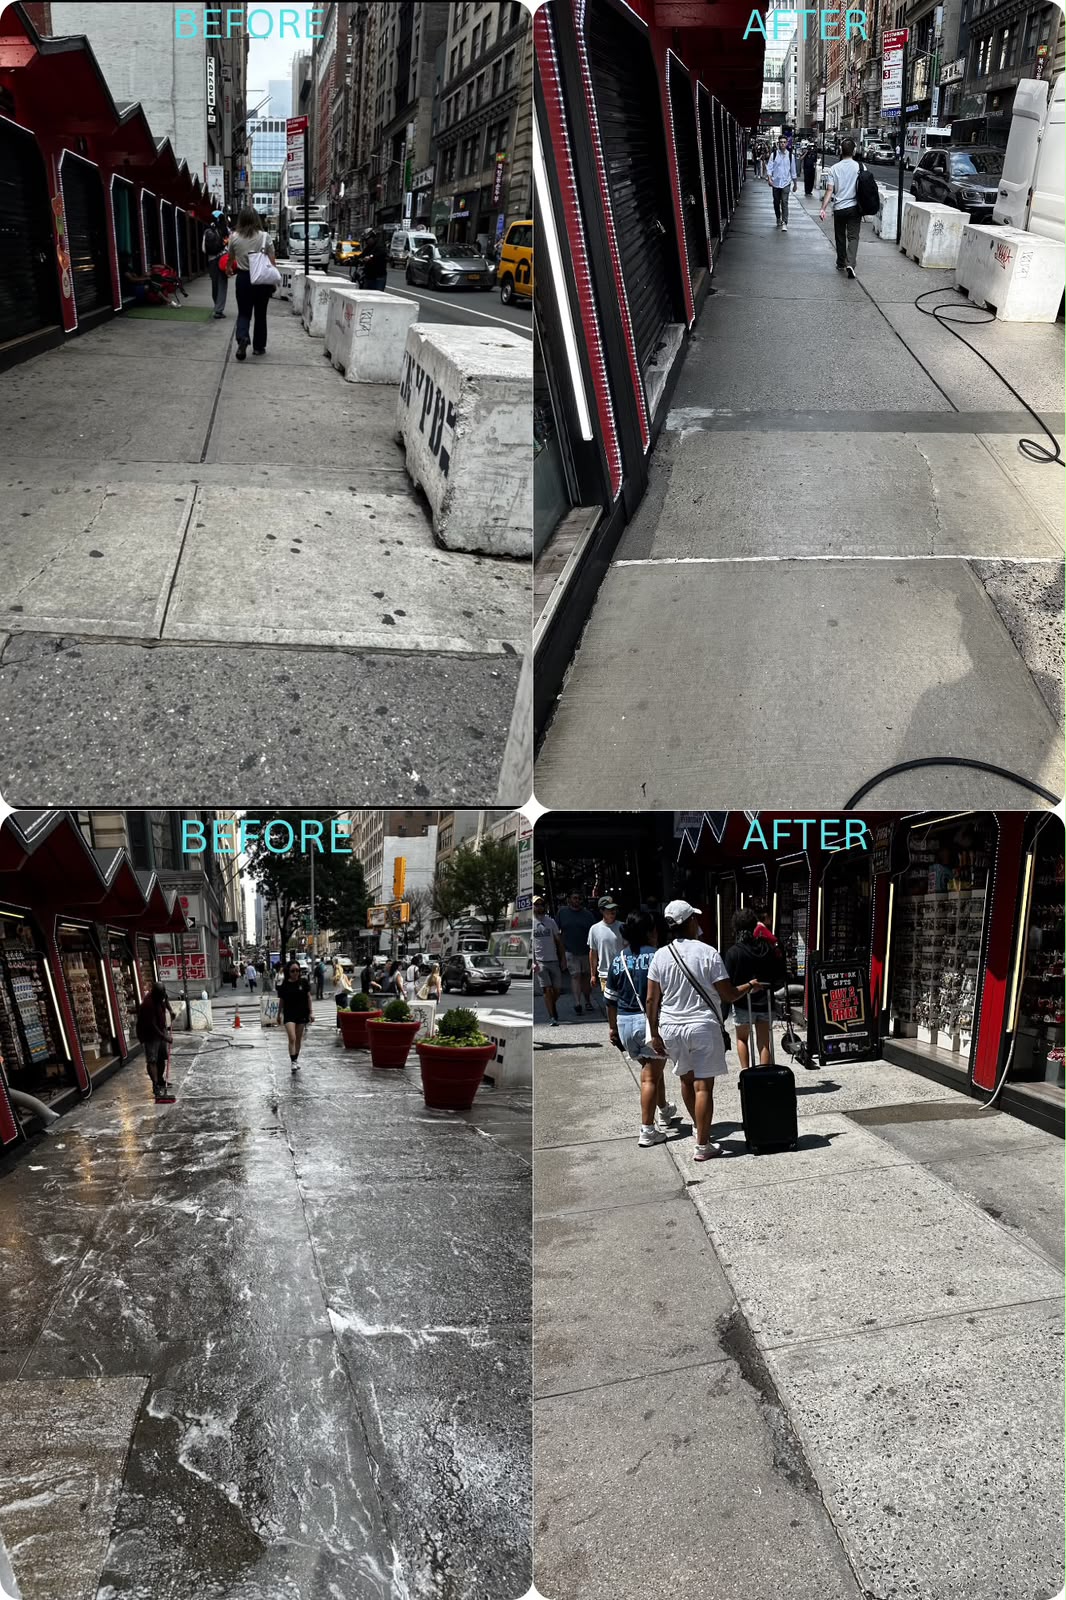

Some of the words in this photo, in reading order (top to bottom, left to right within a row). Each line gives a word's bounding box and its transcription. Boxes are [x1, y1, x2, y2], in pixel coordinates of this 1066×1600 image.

[884, 70, 890, 79] 3
[521, 840, 528, 851] 2
[830, 988, 847, 1000] BUY
[848, 986, 856, 998] 2
[828, 999, 851, 1010] GET
[832, 1006, 858, 1022] FREE
